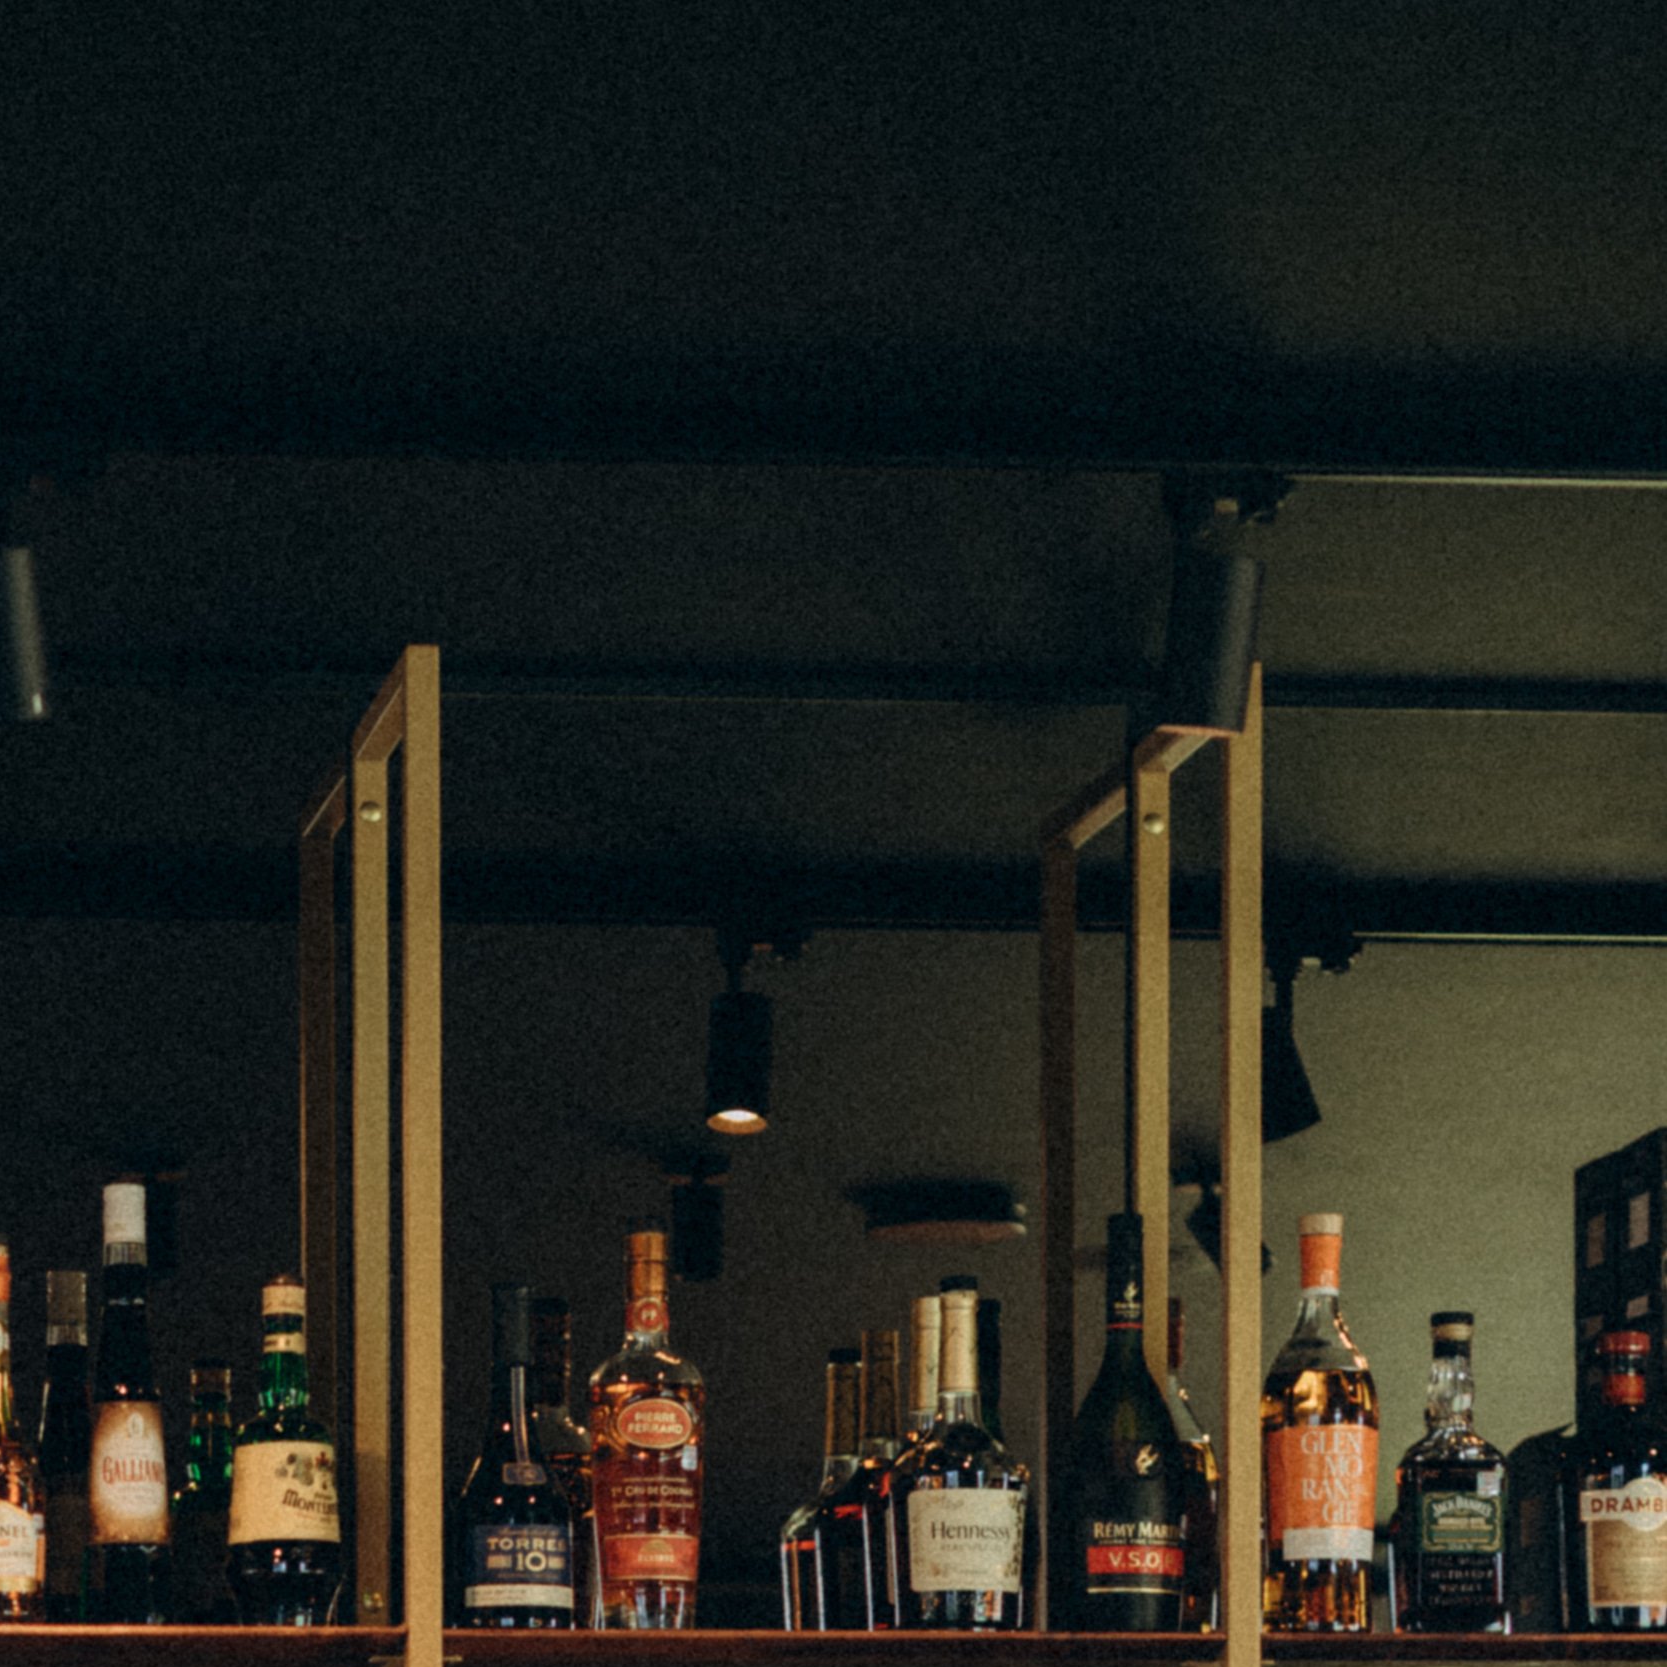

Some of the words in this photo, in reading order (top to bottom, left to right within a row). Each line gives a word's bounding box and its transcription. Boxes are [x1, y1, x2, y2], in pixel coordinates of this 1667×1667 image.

[1300, 1431, 1363, 1455] GLEN
[1322, 1455, 1363, 1477] MO
[1302, 1478, 1350, 1500] RAN
[1322, 1501, 1358, 1523] GIE
[931, 1521, 1011, 1543] Hennessy
[516, 1551, 547, 1572] 10
